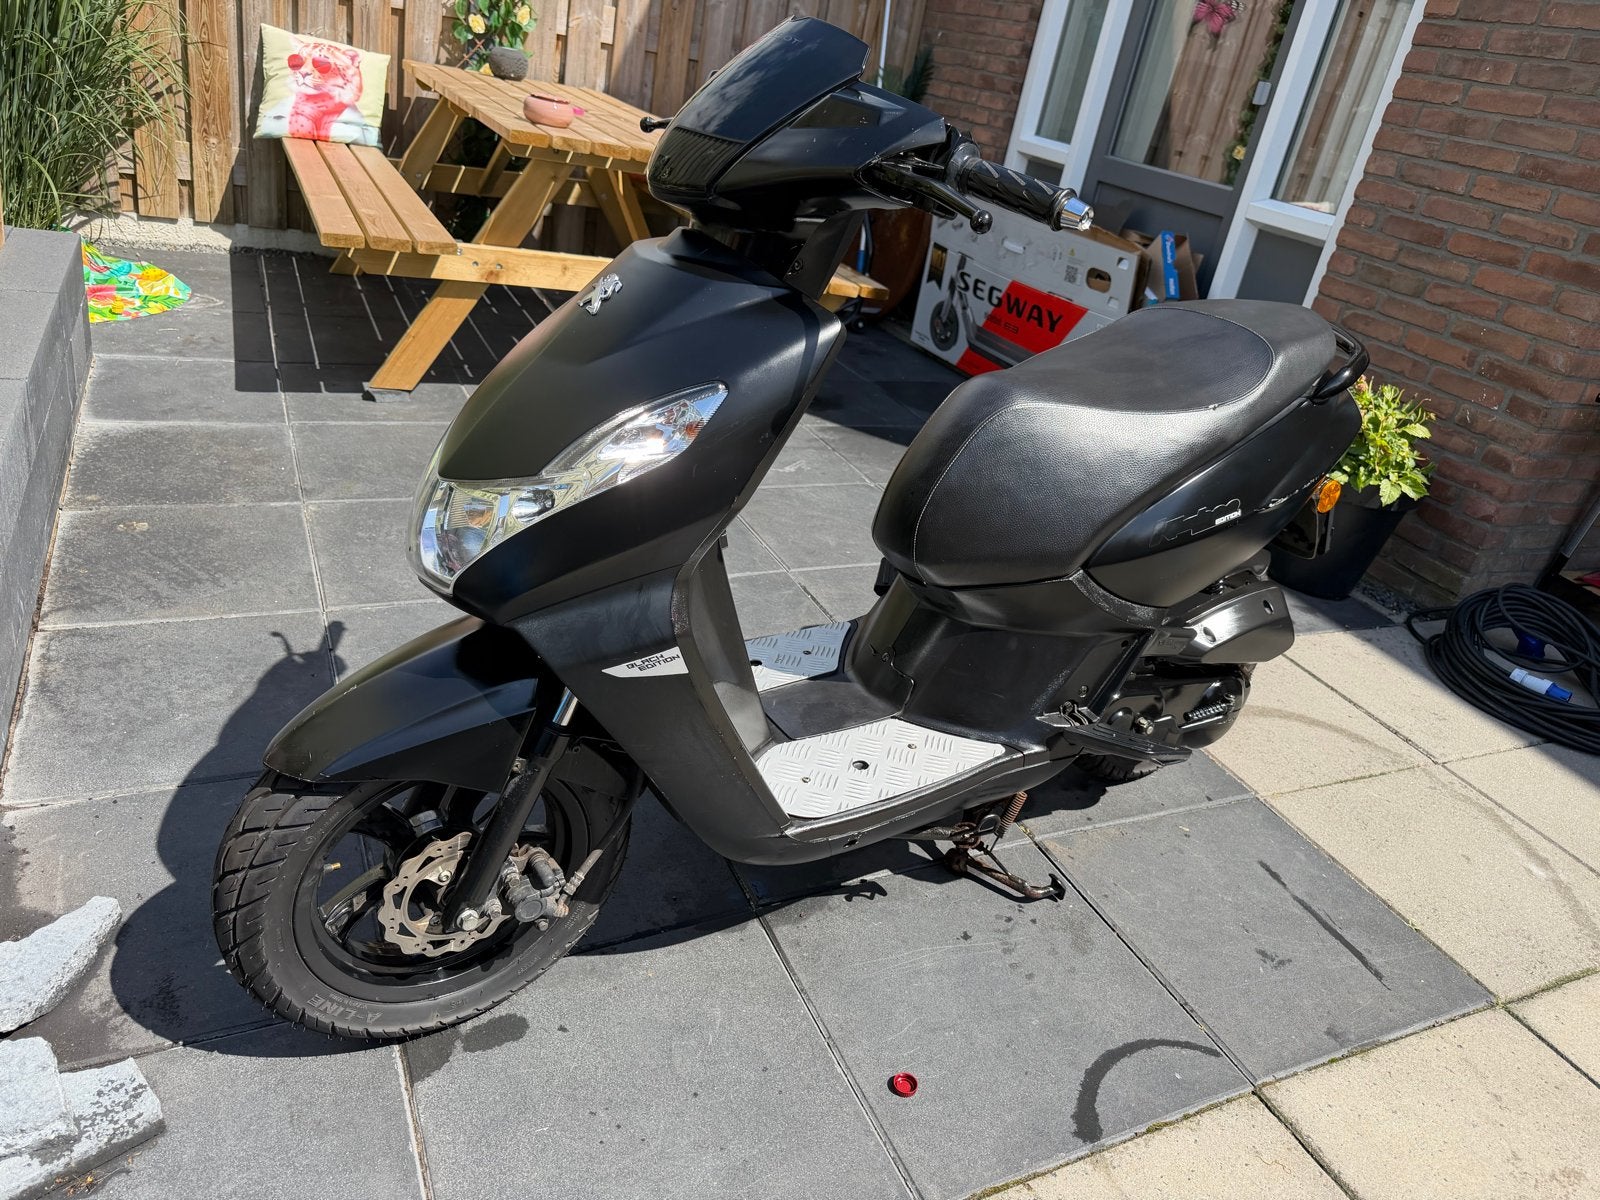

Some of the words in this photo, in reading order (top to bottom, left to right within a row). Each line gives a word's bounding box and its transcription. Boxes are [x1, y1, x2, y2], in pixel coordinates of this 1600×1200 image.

[957, 271, 1063, 334] SEGWAY
[626, 654, 665, 670] BLACK
[638, 654, 680, 671] EDITION
[307, 993, 384, 1025] A-LINE
